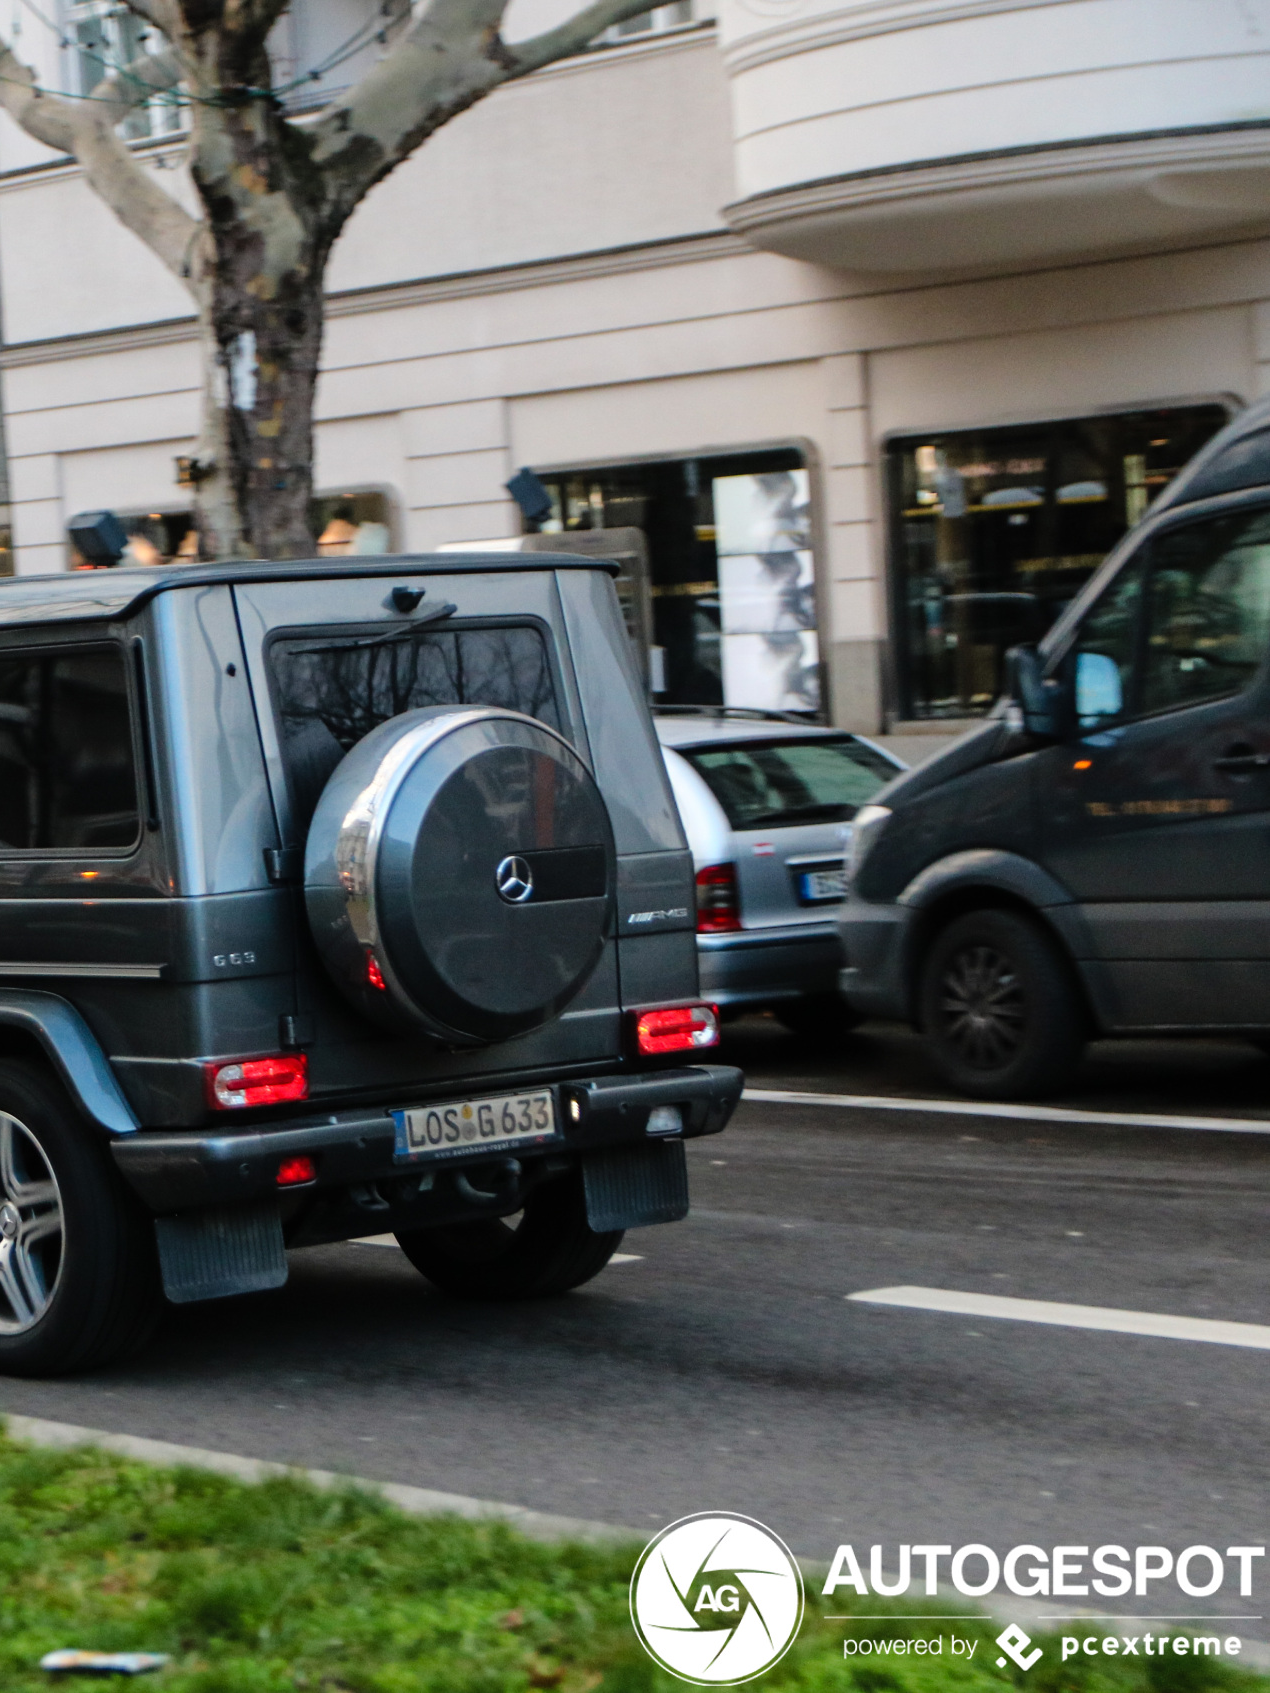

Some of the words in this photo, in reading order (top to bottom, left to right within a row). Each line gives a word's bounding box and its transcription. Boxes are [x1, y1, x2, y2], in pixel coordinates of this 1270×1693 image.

[407, 1109, 461, 1148] LOS
[478, 1104, 496, 1138] G
[501, 1096, 550, 1134] 633
